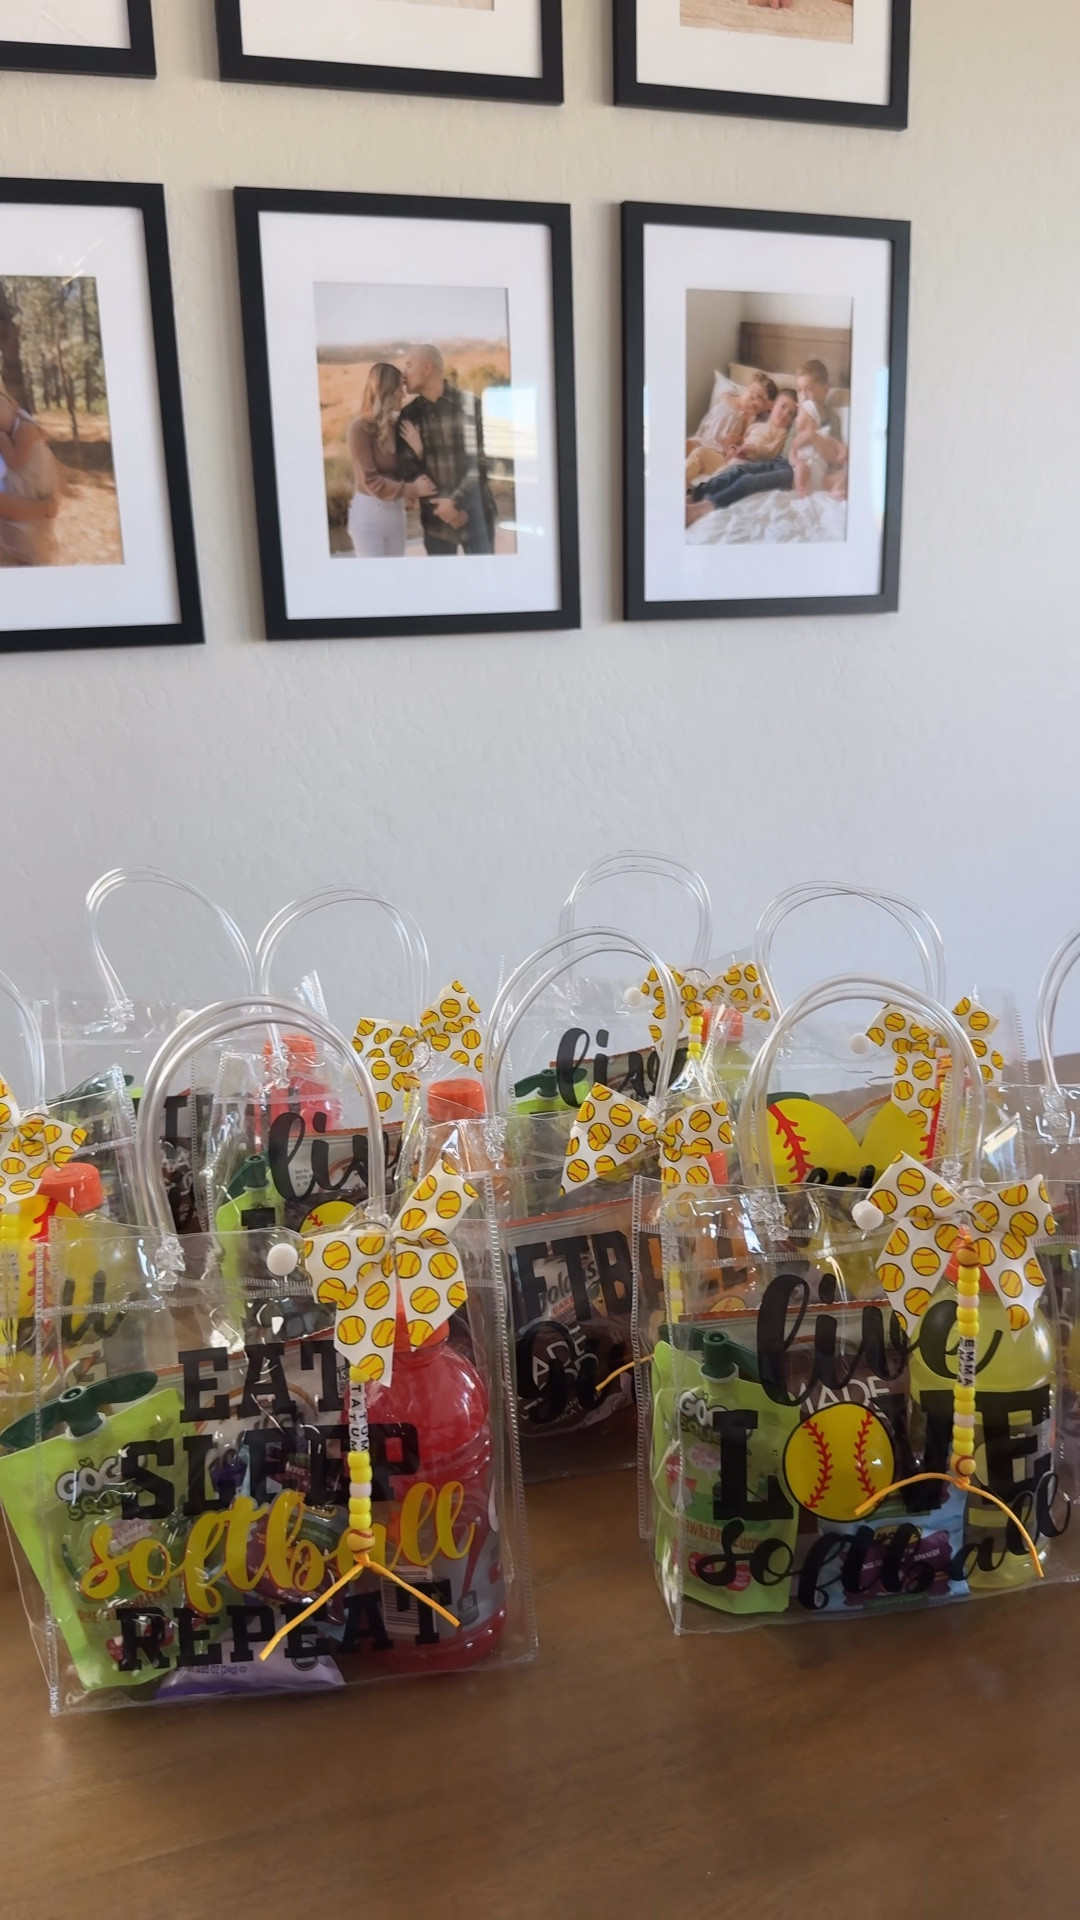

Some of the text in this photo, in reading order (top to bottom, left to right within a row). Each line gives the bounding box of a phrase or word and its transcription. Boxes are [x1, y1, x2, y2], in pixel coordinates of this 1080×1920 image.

[178, 1340, 346, 1423] EAT
[964, 1339, 975, 1386] EMMA
[349, 1384, 362, 1452] TATUM
[81, 1481, 475, 1614] softball
[115, 1579, 453, 1672] REPEAT
